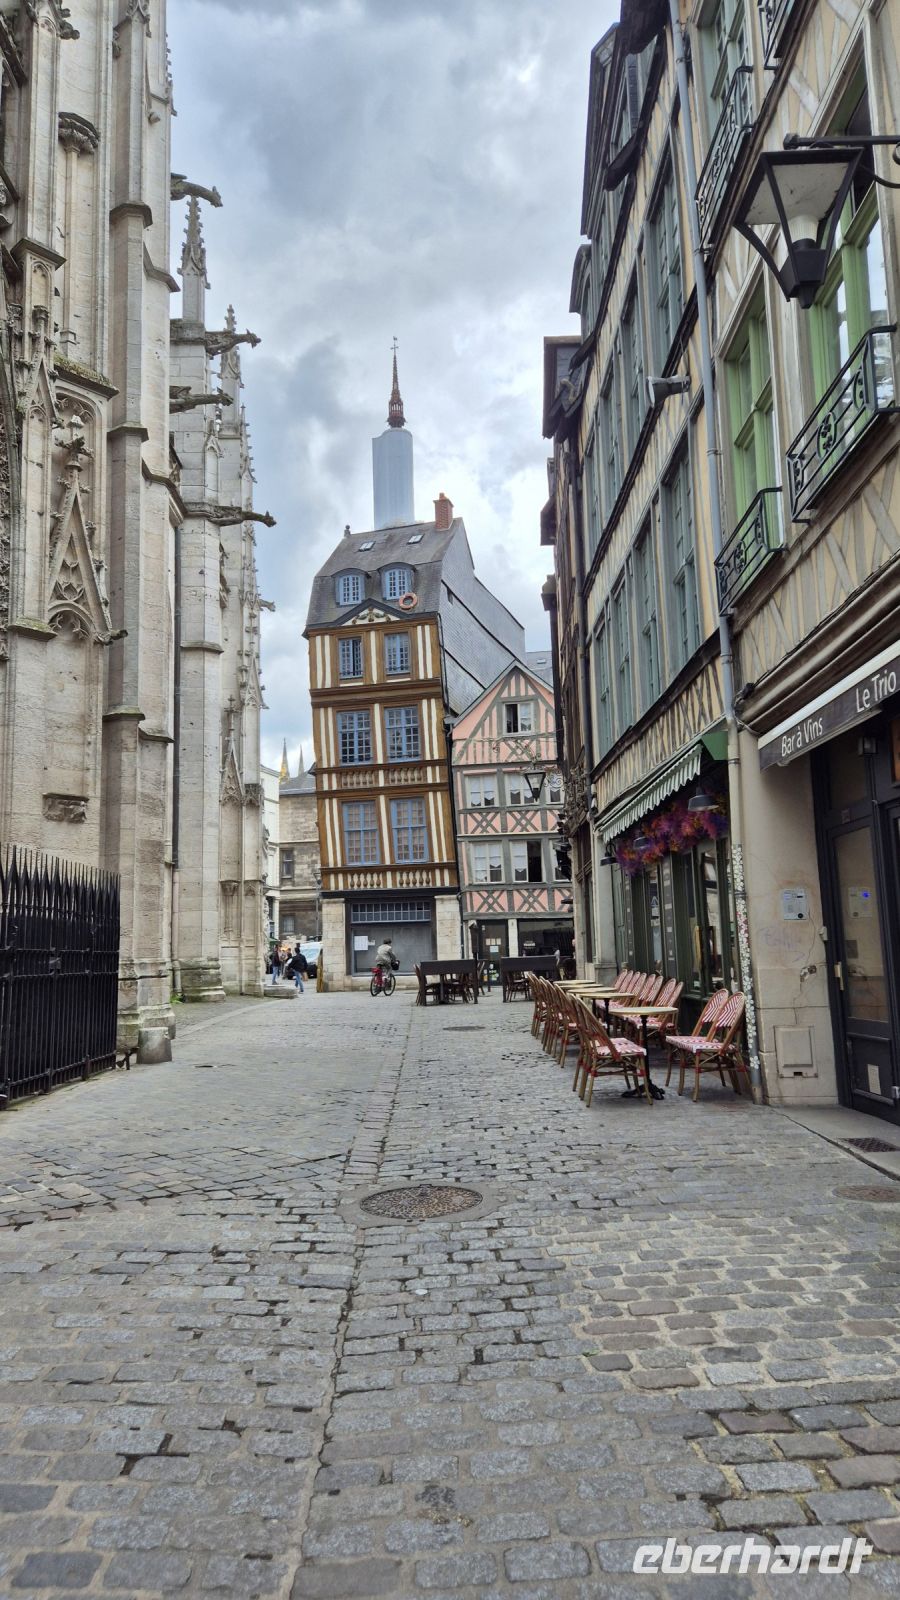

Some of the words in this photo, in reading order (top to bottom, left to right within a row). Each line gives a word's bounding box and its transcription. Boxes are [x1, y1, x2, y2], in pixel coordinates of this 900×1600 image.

[855, 687, 871, 713] Le
[871, 669, 897, 702] Trio
[781, 735, 796, 757] Bar
[796, 726, 803, 748] à
[803, 717, 824, 744] Vins
